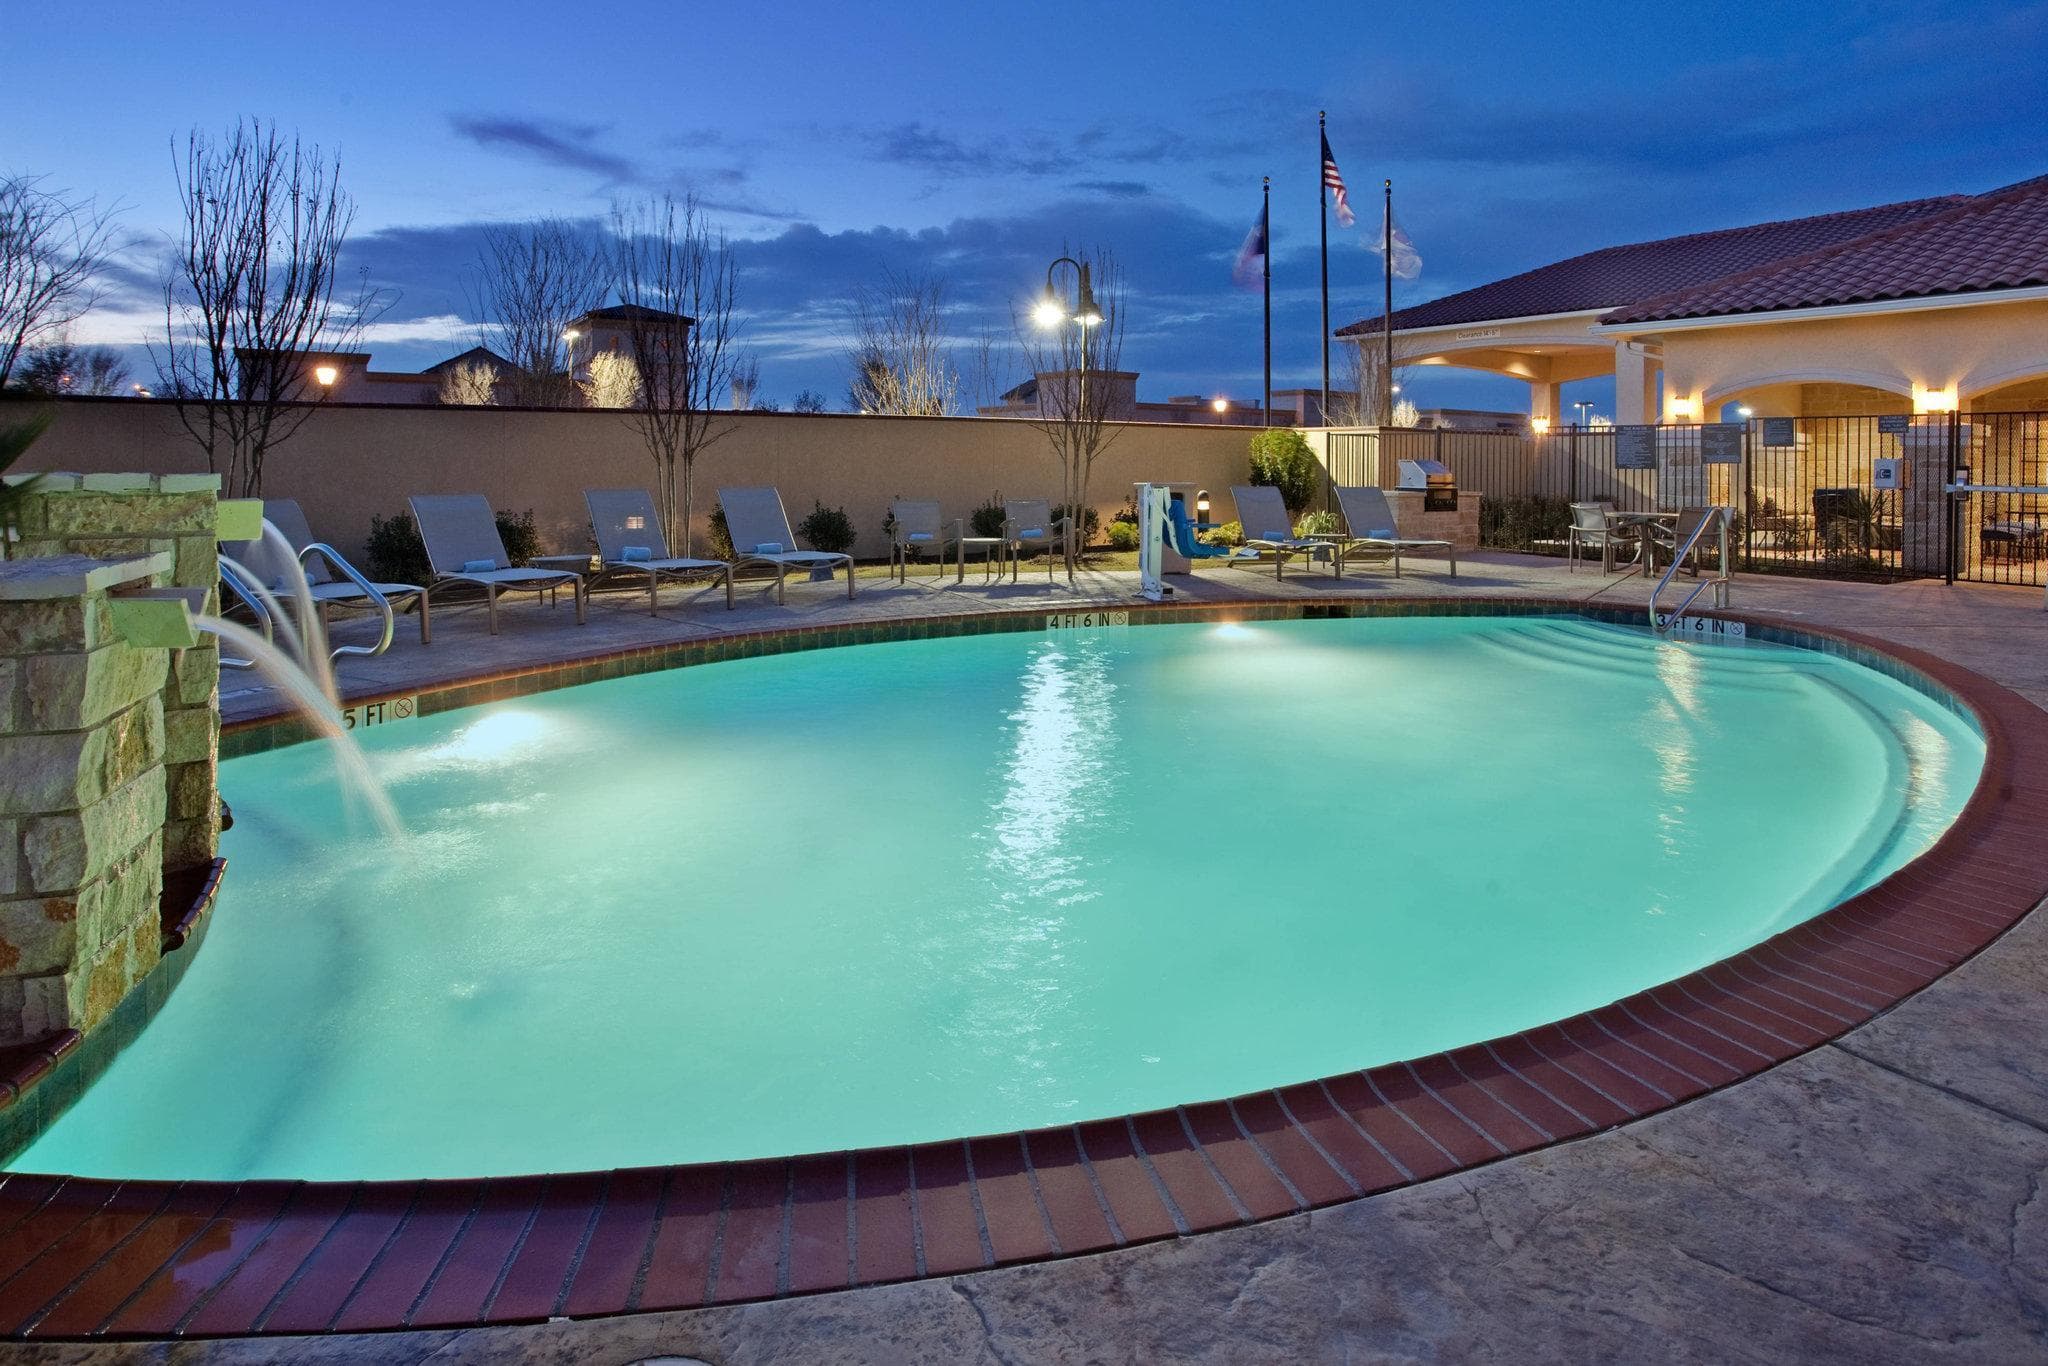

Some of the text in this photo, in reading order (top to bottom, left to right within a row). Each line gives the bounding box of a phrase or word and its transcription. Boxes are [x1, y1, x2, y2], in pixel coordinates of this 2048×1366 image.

[1050, 613, 1110, 629] 4 FT 6 IN
[1657, 614, 1666, 627] 3
[1695, 618, 1704, 631] 6
[1711, 619, 1725, 633] IN
[343, 702, 386, 730] 5 FT
